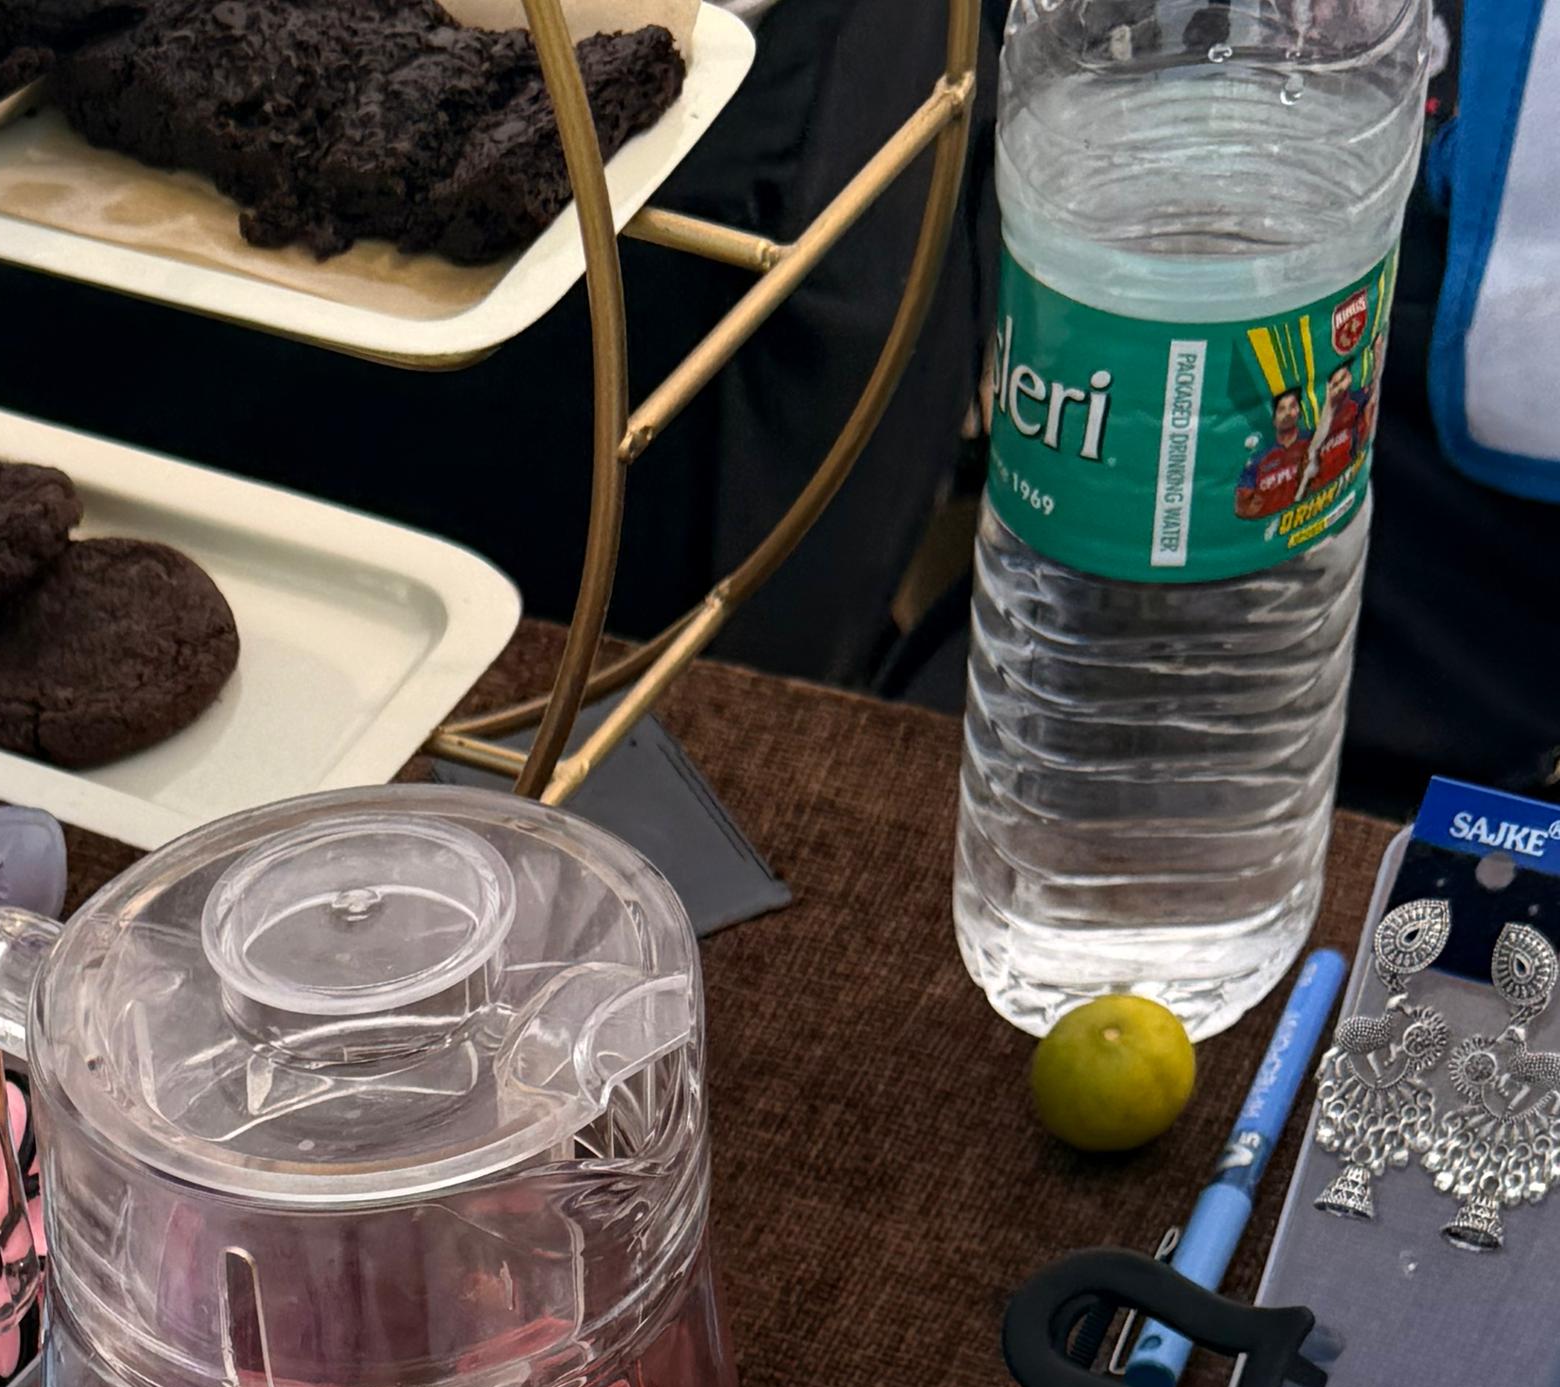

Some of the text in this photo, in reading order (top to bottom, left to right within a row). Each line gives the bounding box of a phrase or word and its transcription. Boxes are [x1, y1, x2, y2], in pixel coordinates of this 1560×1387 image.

[1159, 353, 1198, 553] PACKAGED DRINKING WATER
[1012, 472, 1056, 516] 1969
[1279, 481, 1336, 535] DRINK
[1449, 811, 1549, 858] SAJKE
